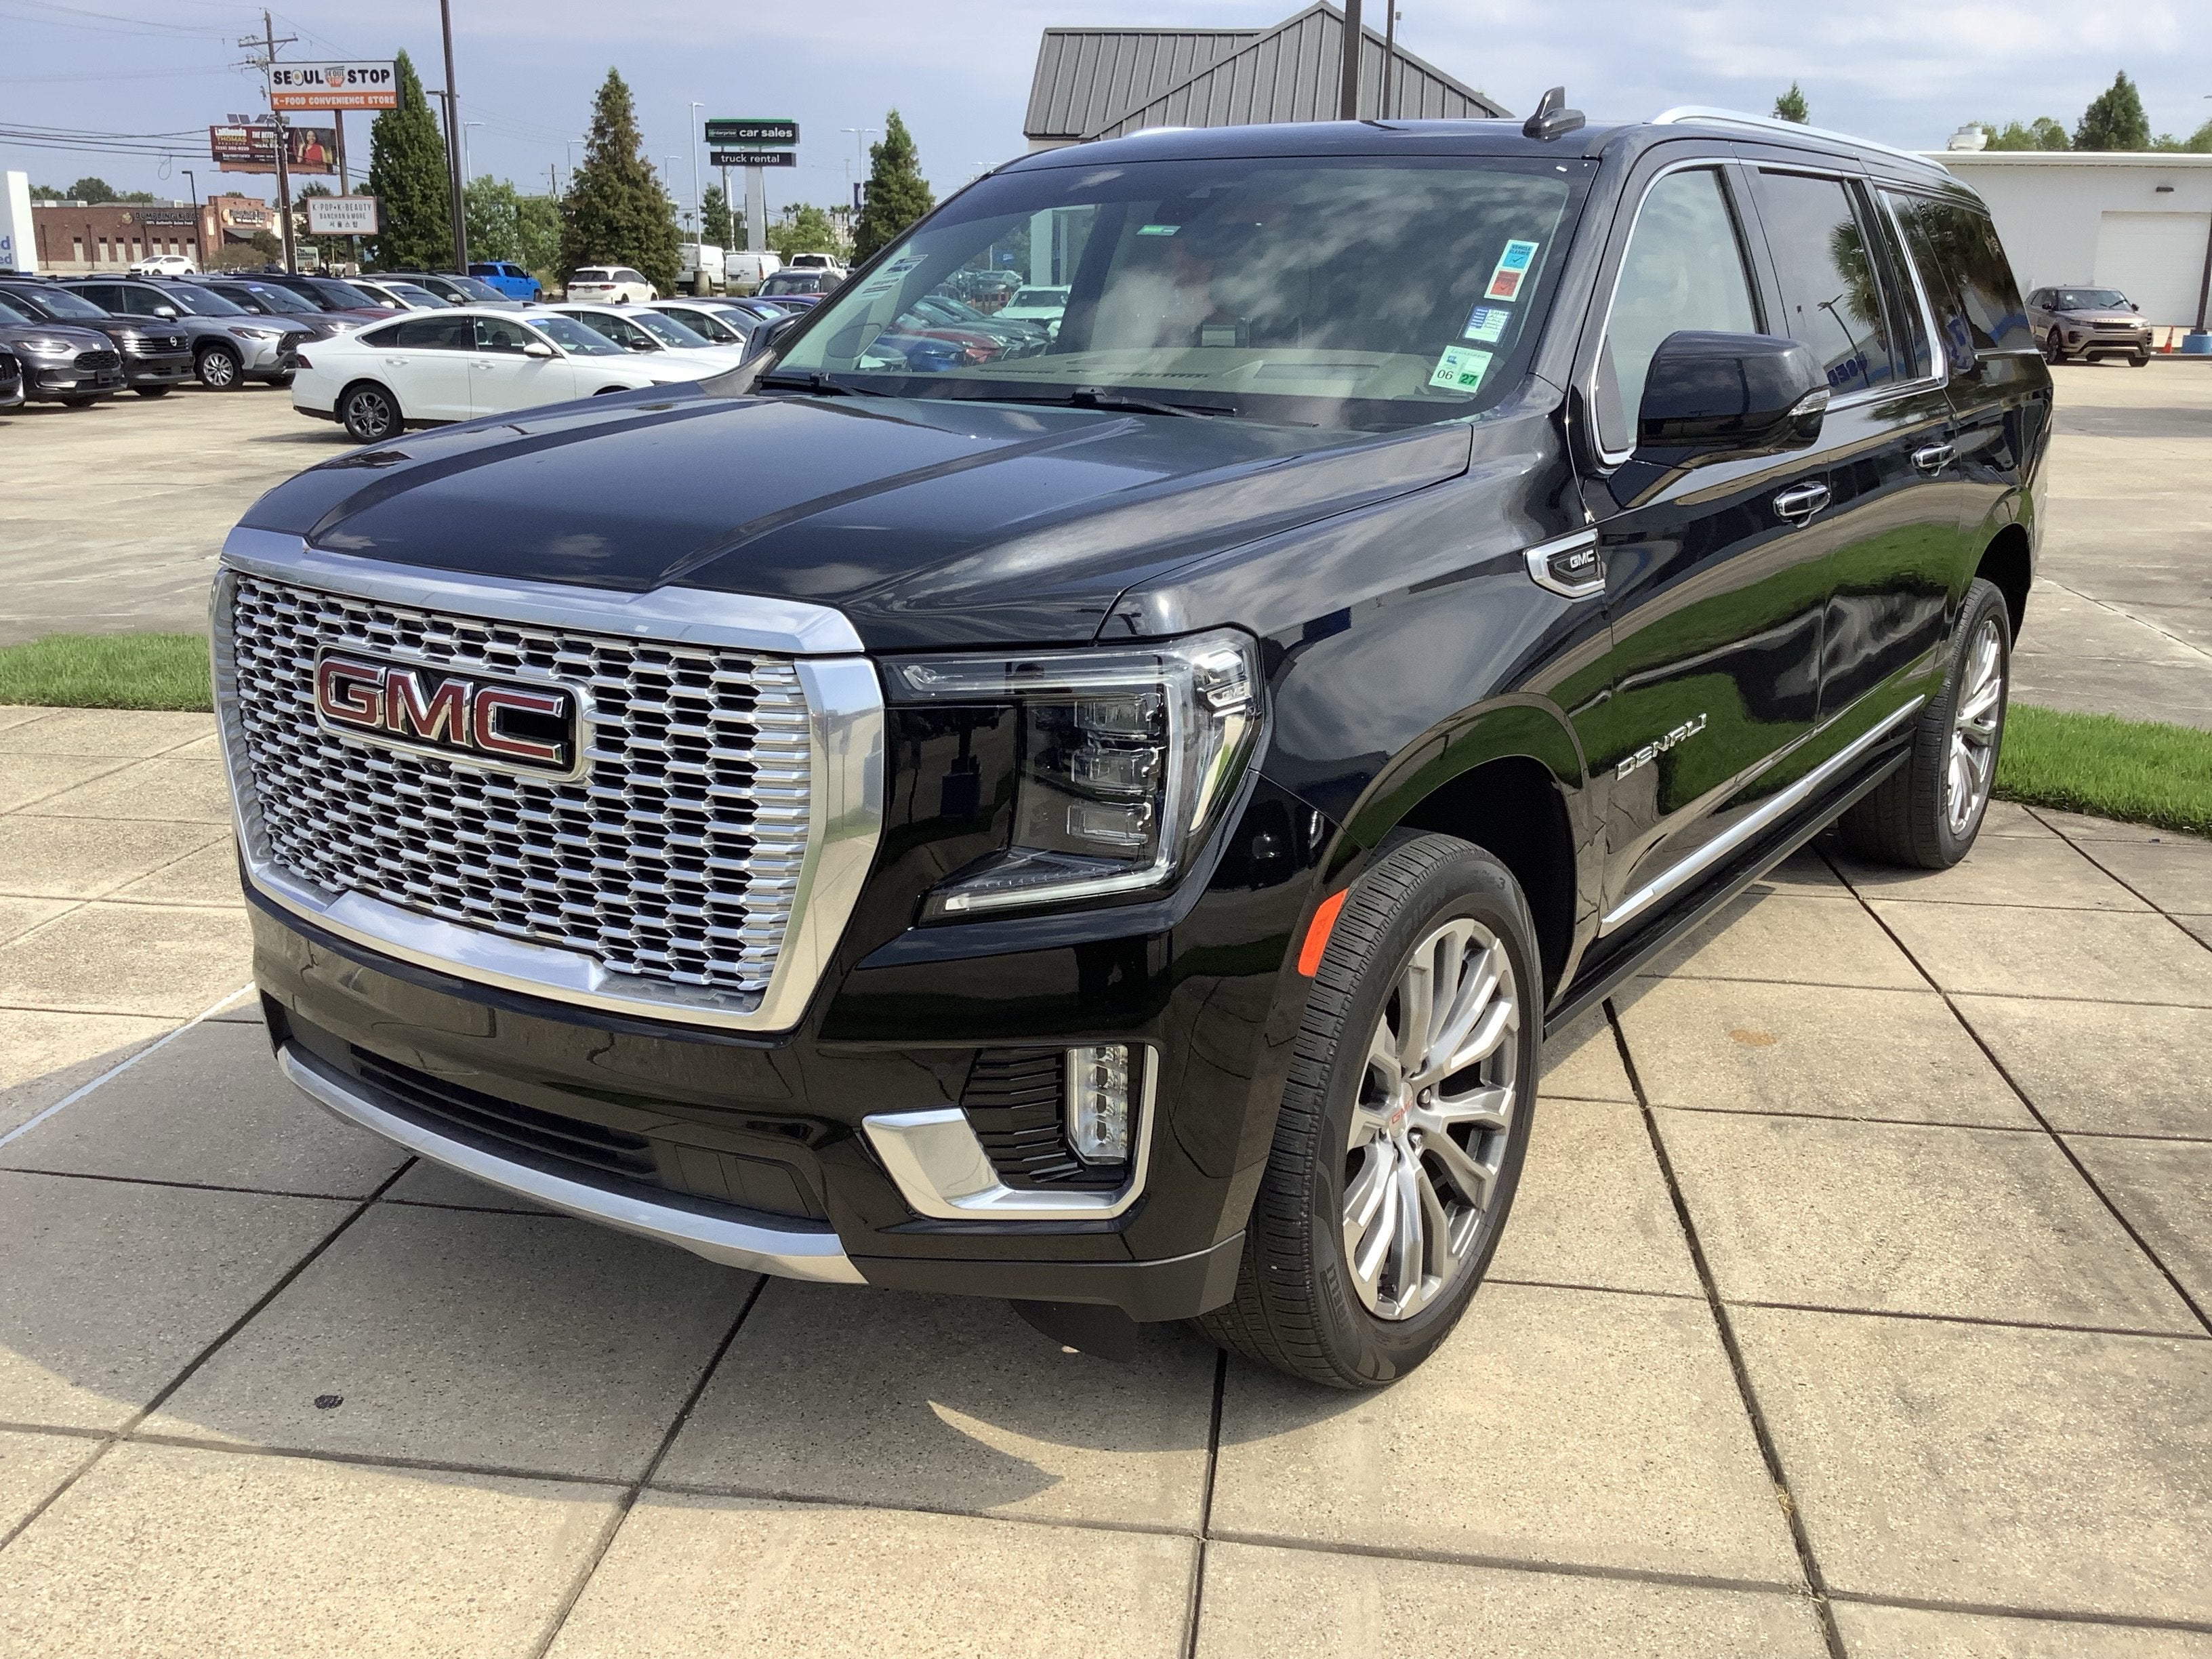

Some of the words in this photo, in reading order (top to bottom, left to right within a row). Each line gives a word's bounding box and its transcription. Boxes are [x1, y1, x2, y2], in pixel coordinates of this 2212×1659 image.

[274, 70, 324, 86] SEOUL
[348, 68, 390, 83] STOP
[308, 96, 365, 105] CONVENIENCE
[367, 96, 394, 104] STORE
[761, 127, 793, 138] sales
[721, 154, 747, 163] truck
[750, 154, 780, 163] rental
[1437, 369, 1454, 380] 06
[1460, 374, 1477, 384] 27
[1570, 550, 1595, 569] GMC
[319, 656, 565, 765] GMC
[1615, 713, 1707, 781] DENALI
